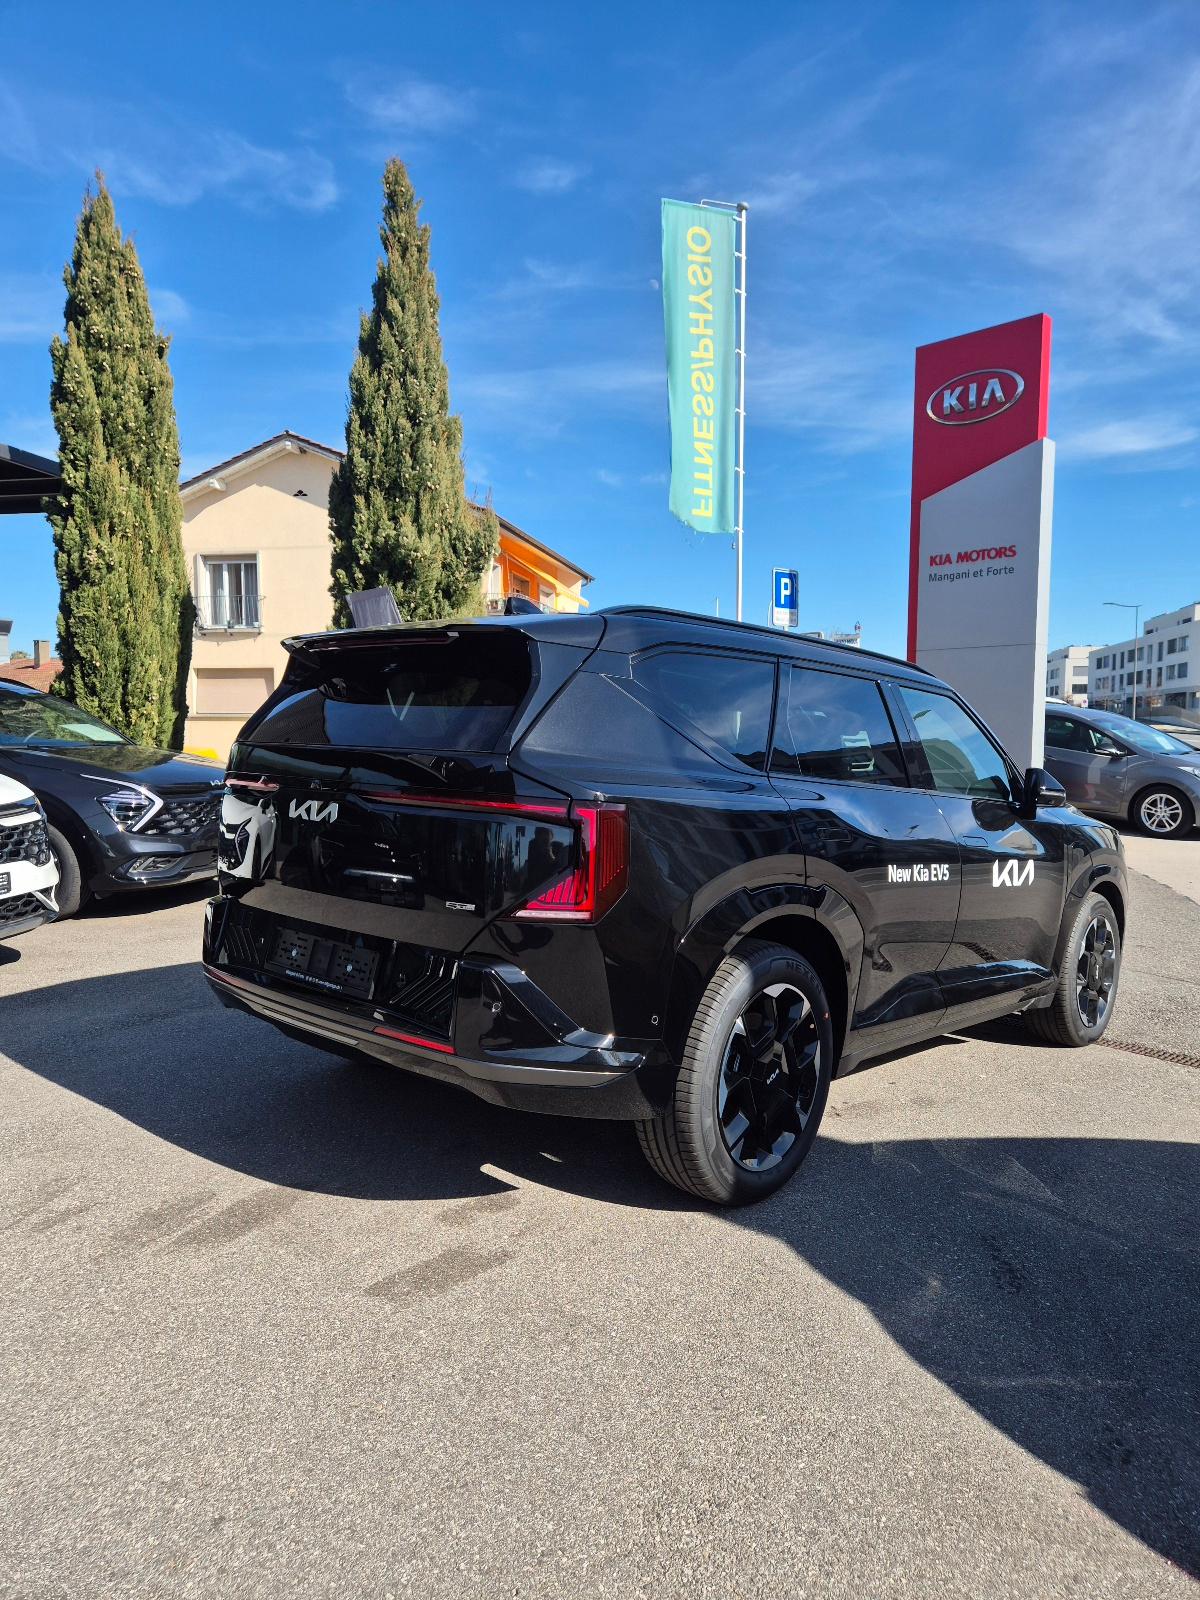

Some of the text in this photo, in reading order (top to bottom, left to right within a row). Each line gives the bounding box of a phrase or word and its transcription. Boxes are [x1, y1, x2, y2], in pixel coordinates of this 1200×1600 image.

[942, 377, 1006, 416] KIA
[929, 545, 1017, 567] KIA MOTORS
[928, 566, 1015, 583] Mangani et Forte
[780, 577, 792, 605] P
[288, 797, 339, 824] KIA
[888, 863, 950, 883] New Kia EV5
[992, 858, 1035, 888] KIA
